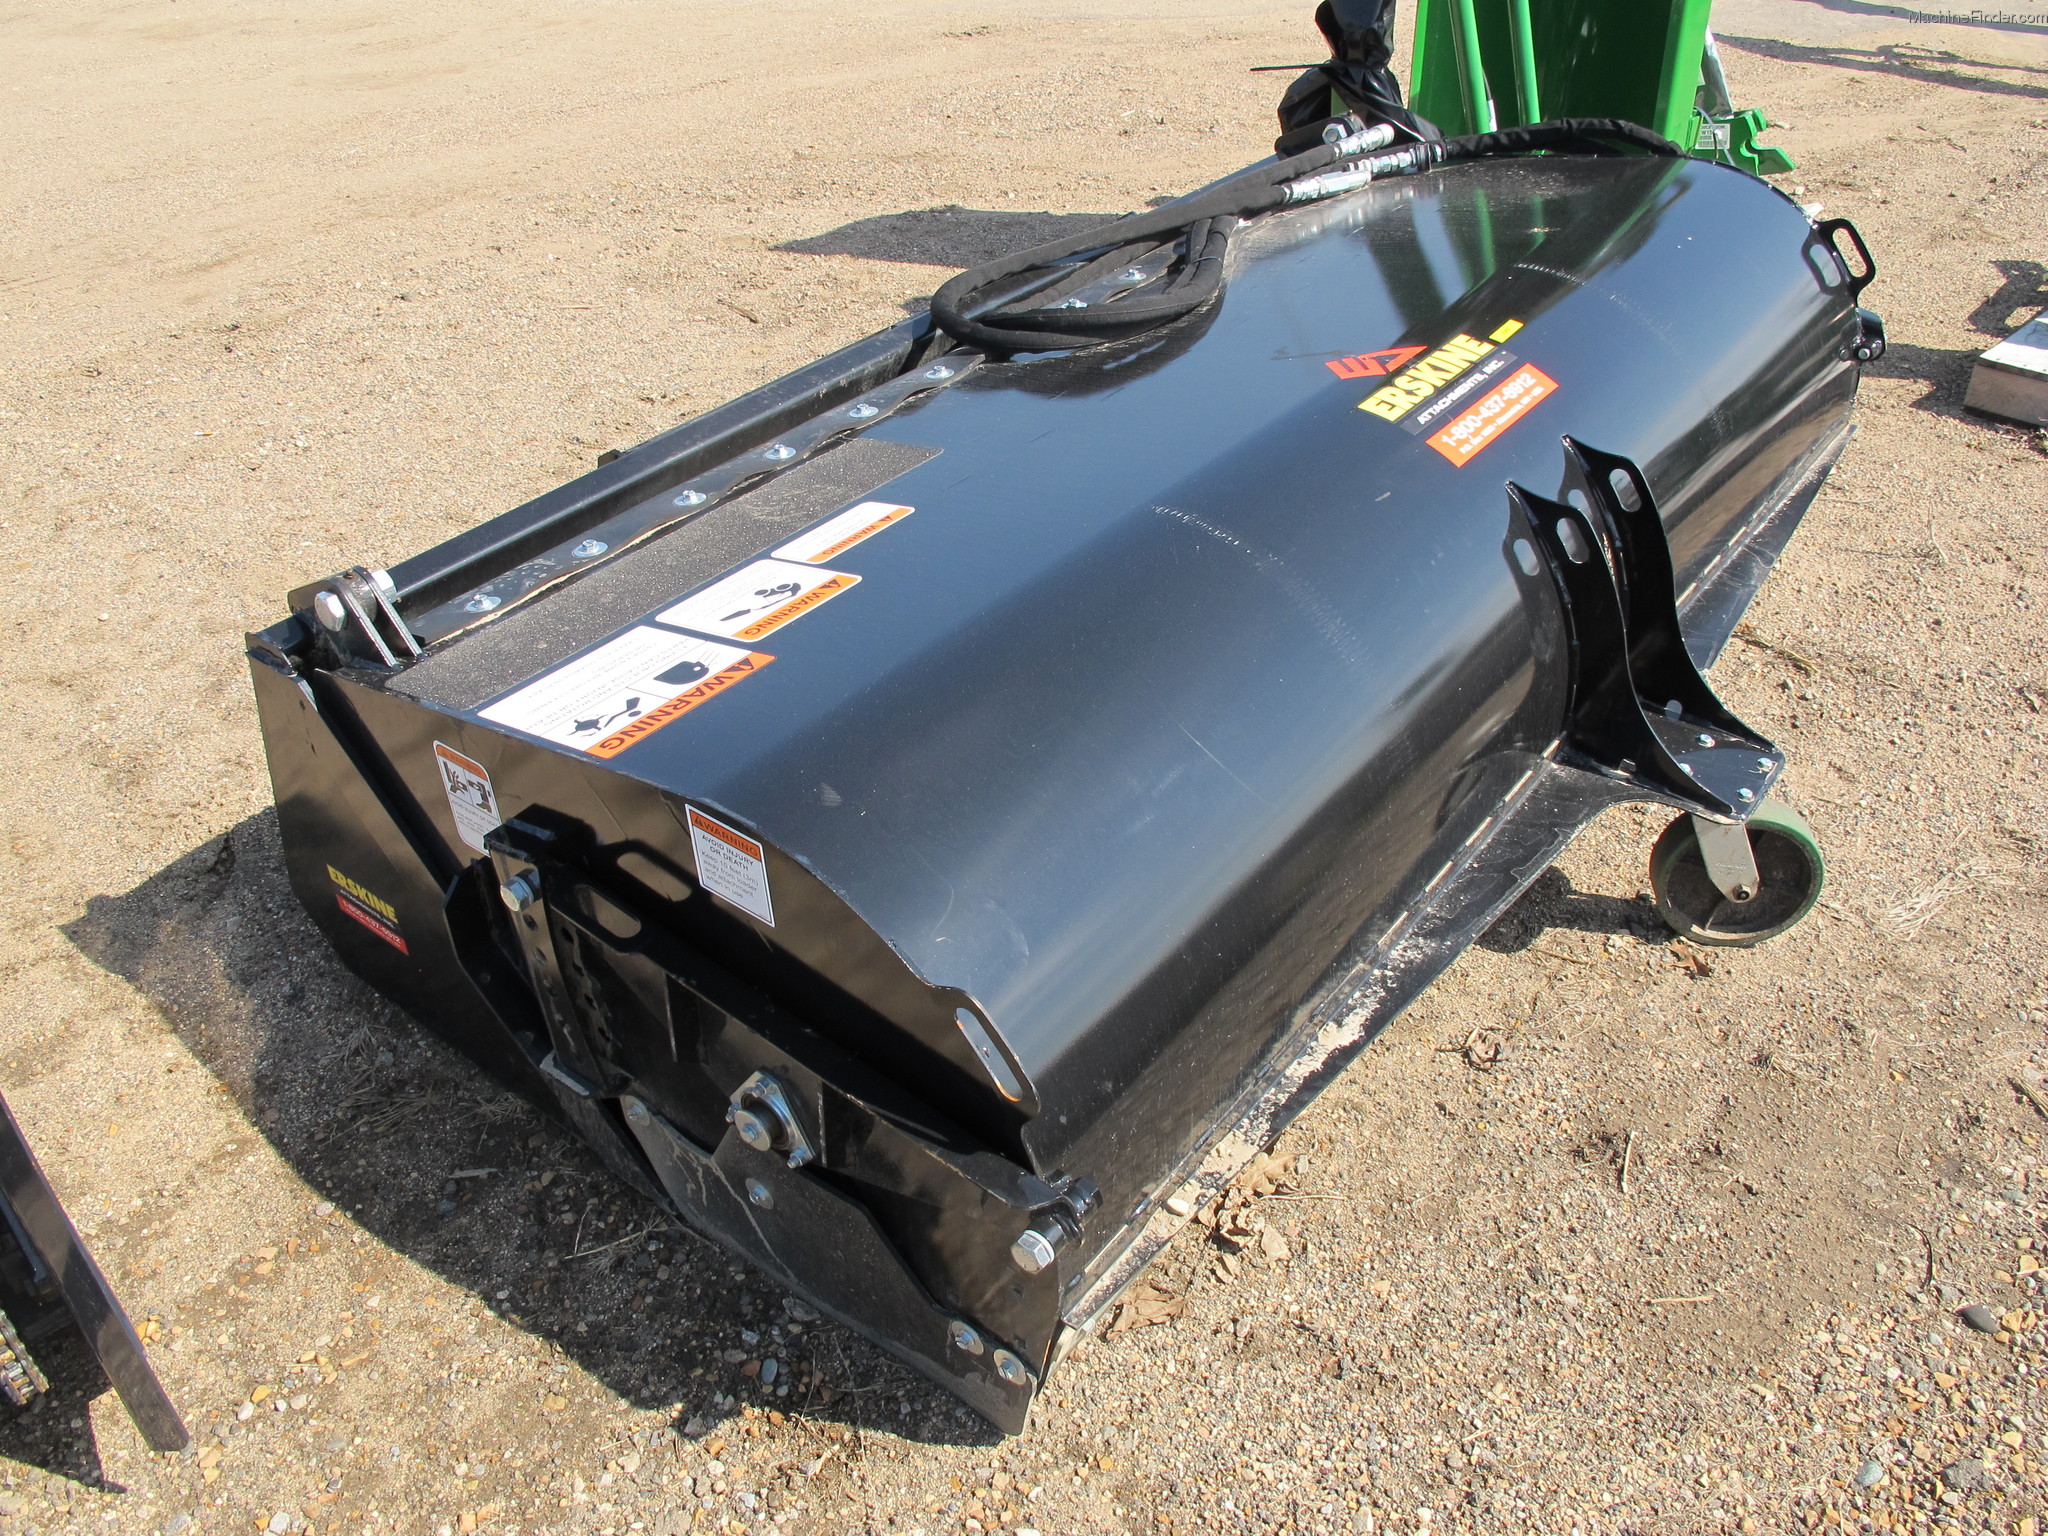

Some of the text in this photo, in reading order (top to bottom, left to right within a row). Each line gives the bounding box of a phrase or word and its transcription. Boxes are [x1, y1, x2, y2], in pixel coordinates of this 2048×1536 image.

[1357, 333, 1498, 423] ERSKINE
[1416, 371, 1489, 425] ATTACHMENTS,
[1482, 359, 1505, 375] INC.
[818, 524, 881, 556] WARNING
[740, 590, 826, 636] WARNING
[595, 672, 735, 752] WARNING
[700, 832, 754, 867] AVOID INJURY
[702, 820, 758, 857] WARNING
[701, 850, 718, 864] Keep
[702, 858, 720, 873] away
[703, 865, 717, 877] and
[708, 844, 749, 872] OR DEATH
[326, 864, 399, 924] ERSKINE
